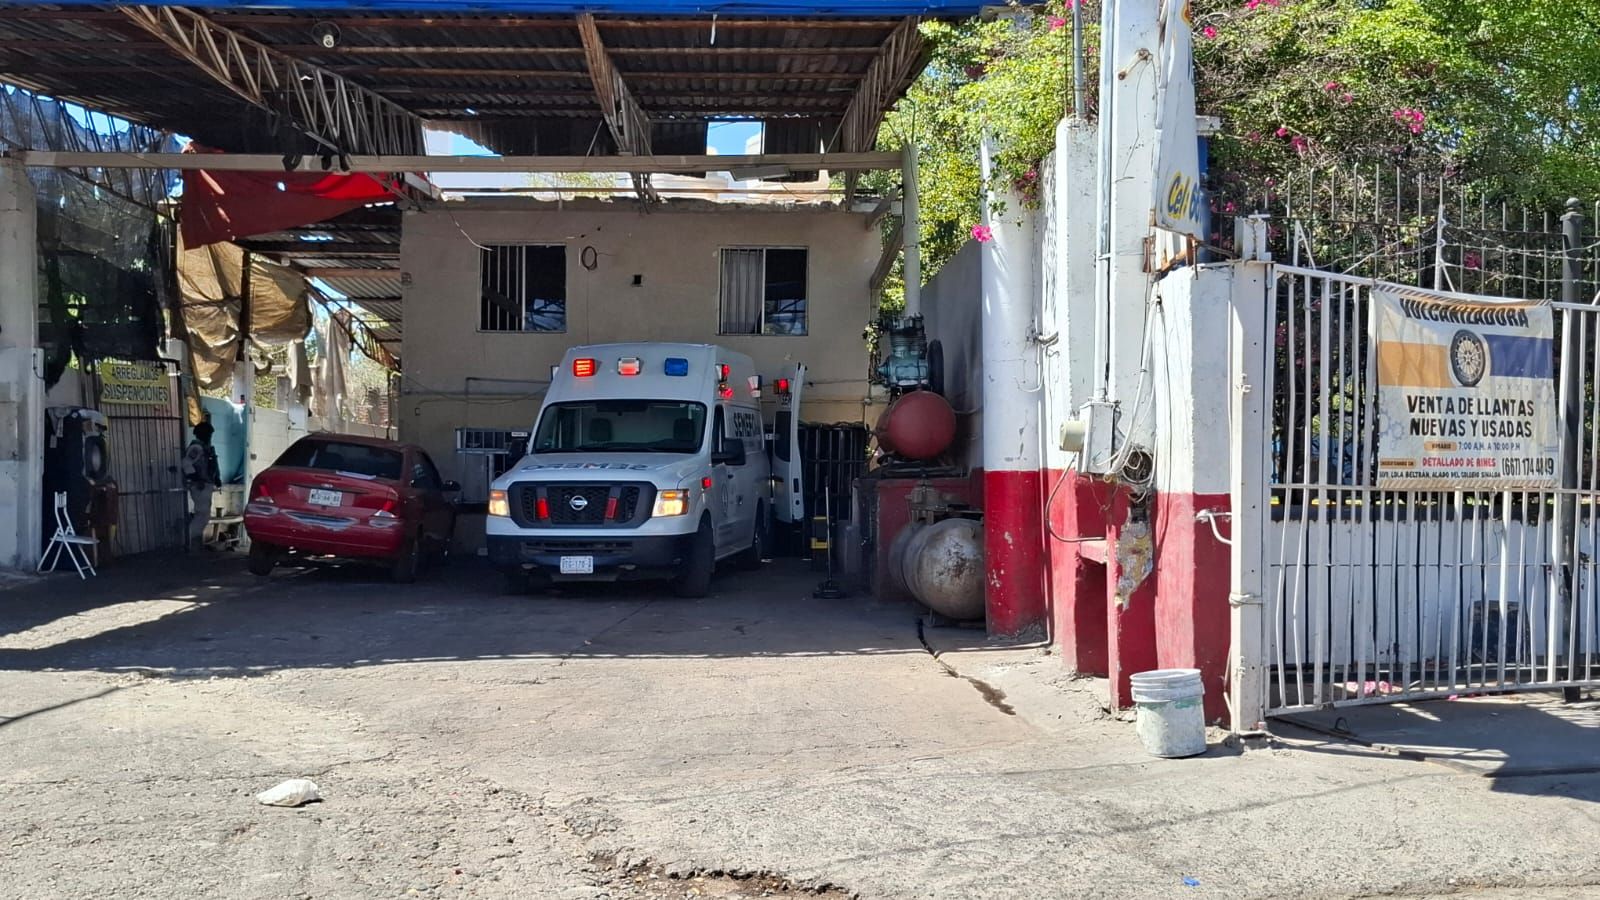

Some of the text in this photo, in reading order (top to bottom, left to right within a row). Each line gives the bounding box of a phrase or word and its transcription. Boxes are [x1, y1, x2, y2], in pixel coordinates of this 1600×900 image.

[1400, 298, 1530, 328] VULCANIZADORA
[111, 365, 160, 381] ARREGLAMOS
[104, 383, 168, 401] SUSPENCIONES
[1407, 395, 1534, 417] VENTA DE LLANTAS
[1410, 417, 1532, 438] NUEVAS Y USADAS
[1422, 457, 1464, 467] DETALLADO
[1466, 457, 1474, 467] DE
[1476, 457, 1496, 468] RINES
[1501, 457, 1520, 476] (667)
[1522, 457, 1535, 476] 174
